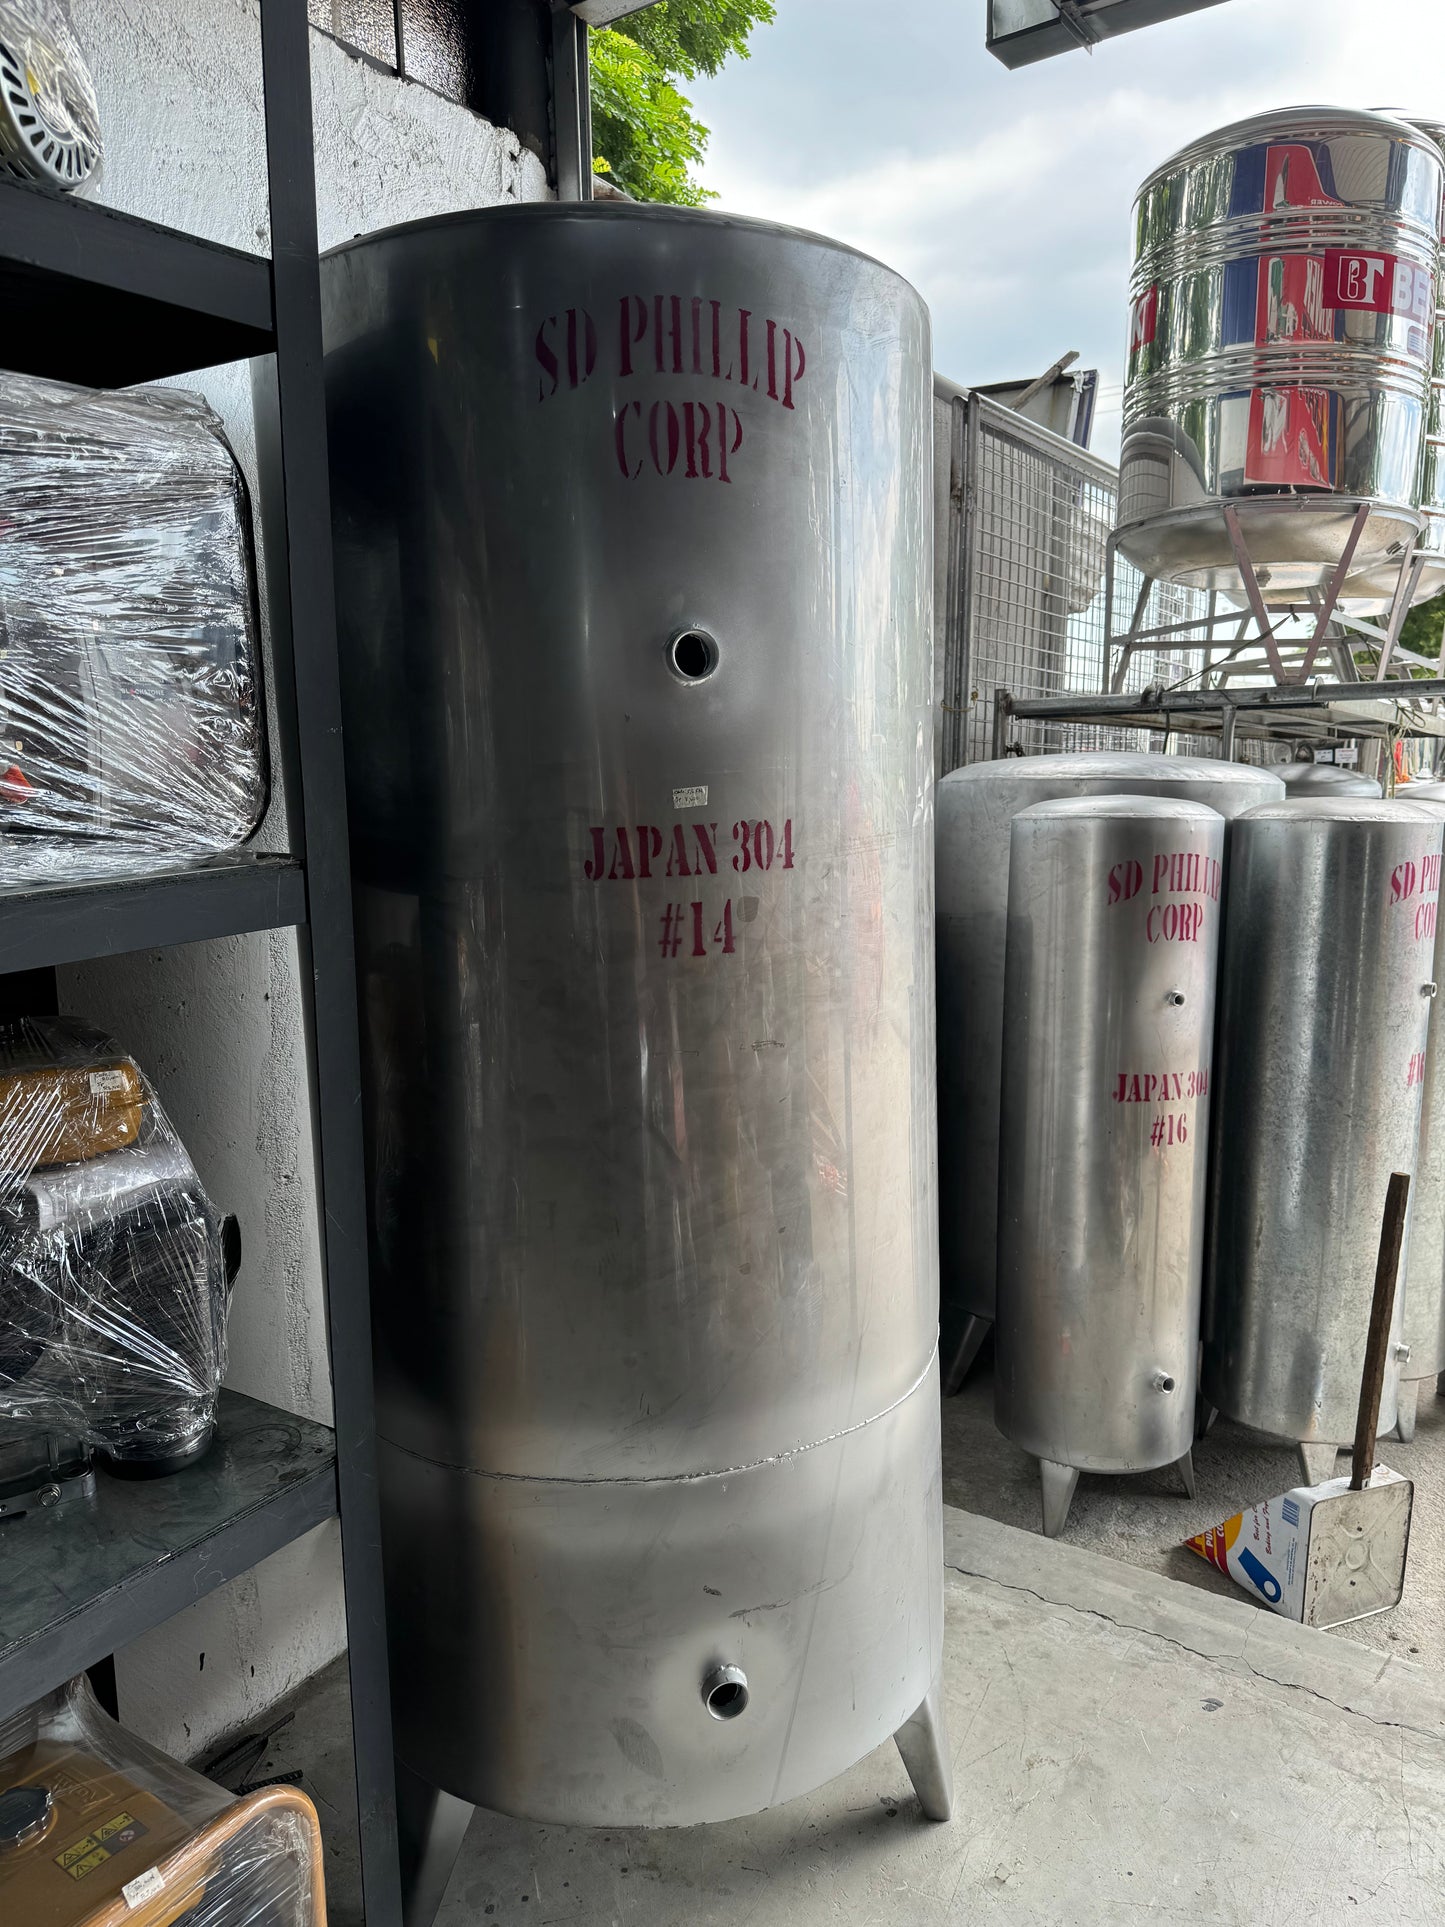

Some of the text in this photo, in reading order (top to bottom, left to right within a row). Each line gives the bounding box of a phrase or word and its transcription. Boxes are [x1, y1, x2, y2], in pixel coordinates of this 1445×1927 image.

[536, 294, 806, 410] SD PHILLIP
[615, 401, 743, 483] CORP
[584, 819, 795, 881] JAPAN 304
[1108, 853, 1220, 906] SD PHILLIP
[1390, 862, 1416, 906] SD
[658, 899, 736, 958] #14
[1146, 903, 1204, 944] CORP
[1112, 1067, 1208, 1103] JAPAN 304
[1150, 1113, 1187, 1147] #16
